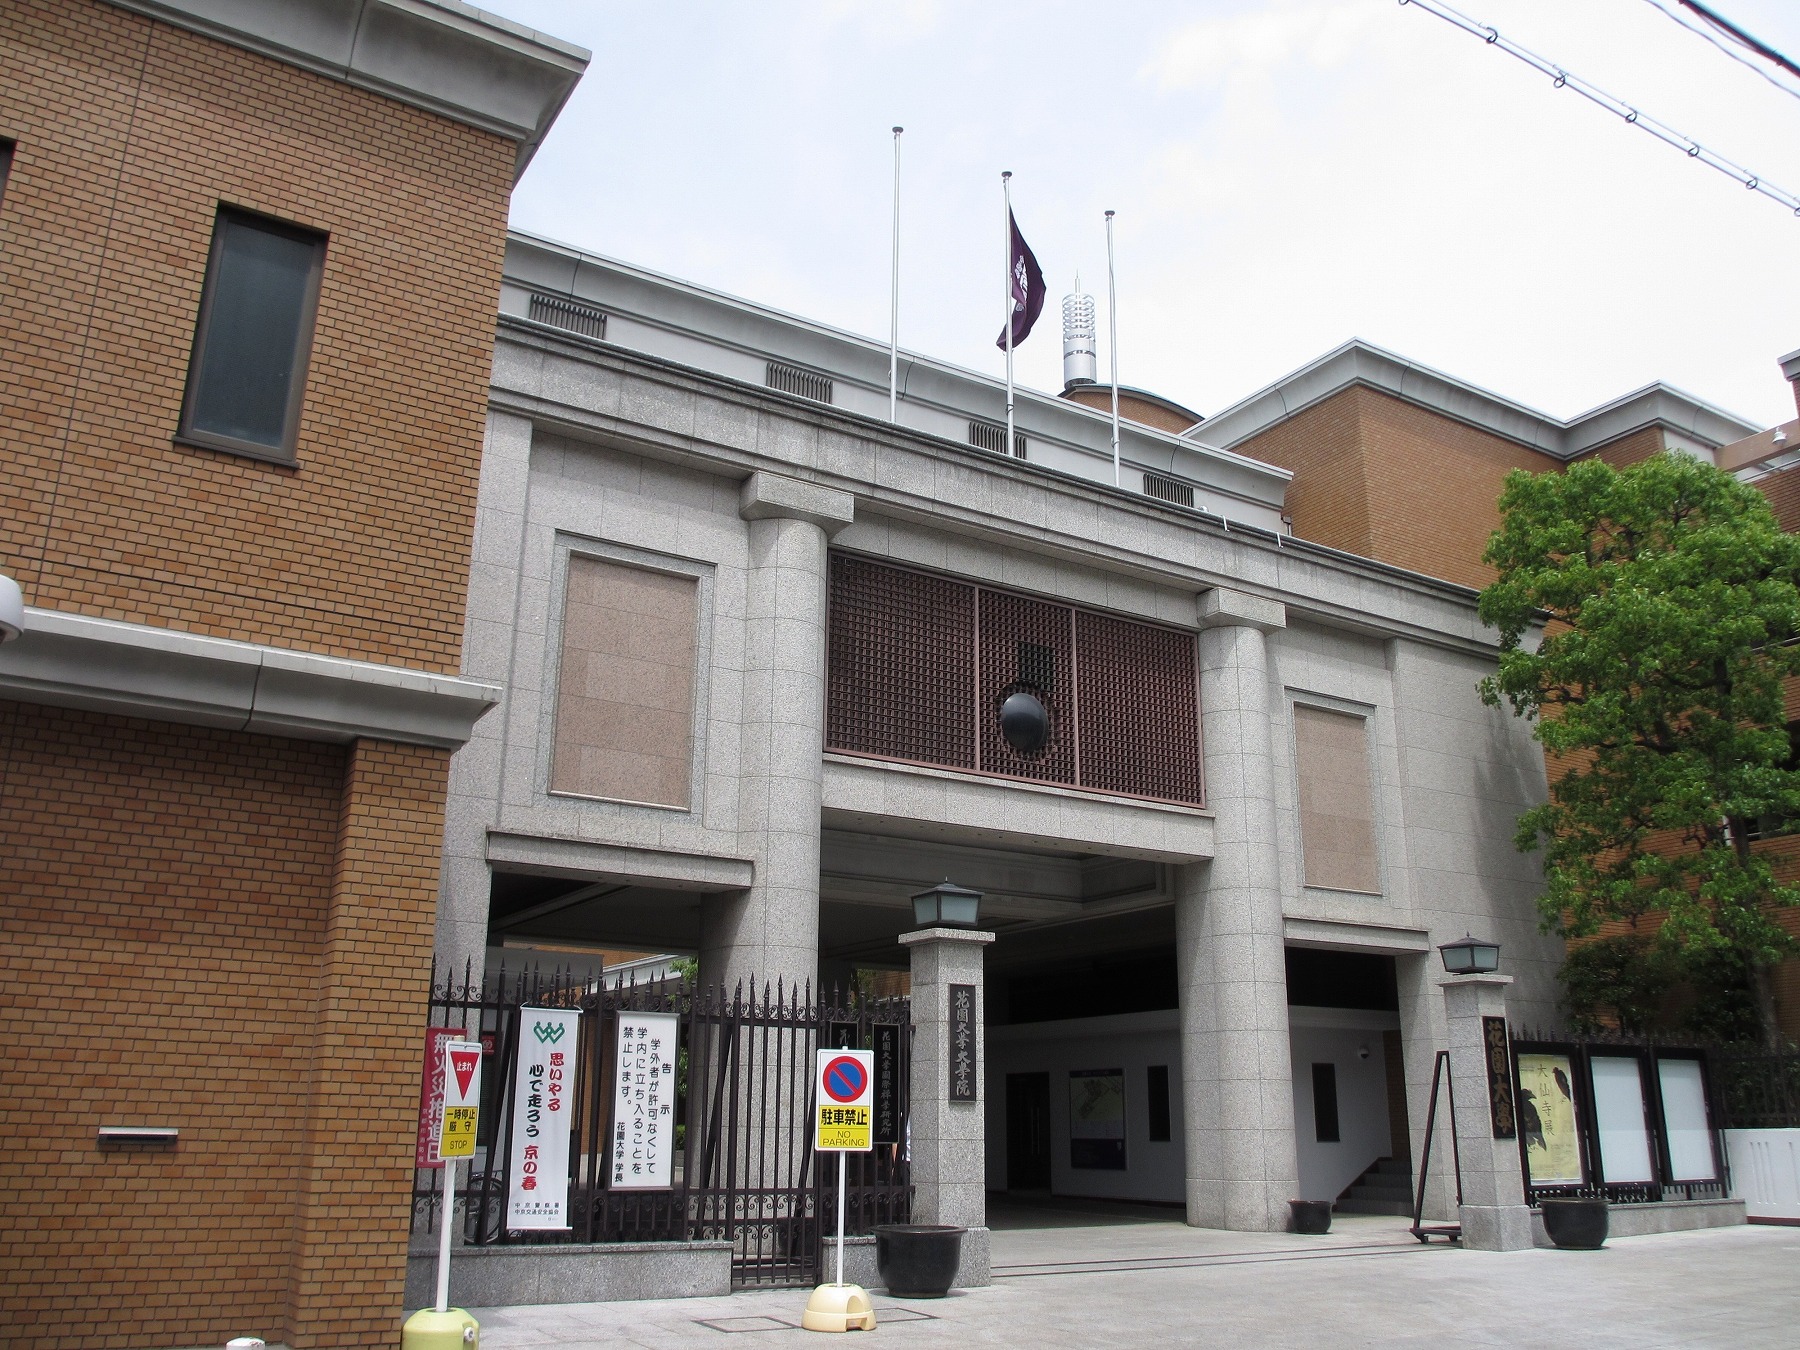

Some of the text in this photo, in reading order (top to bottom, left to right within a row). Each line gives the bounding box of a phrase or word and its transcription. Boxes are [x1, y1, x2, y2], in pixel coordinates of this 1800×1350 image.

[456, 1061, 473, 1072] 止まれ
[547, 1053, 565, 1112] 思いやる
[620, 1026, 634, 1105] 禁止します。
[632, 1026, 648, 1175] 学内に立ち入ることを
[646, 1038, 661, 1174] 学外者が許可なくして
[660, 1063, 672, 1115] 告示
[446, 1108, 476, 1120] 一時停止
[521, 1064, 545, 1191] 心で走ろう 京の春
[821, 1108, 868, 1126] 駐車禁止
[449, 1139, 468, 1150] STOP
[822, 1138, 865, 1147] PARKING
[837, 1130, 851, 1139] NO
